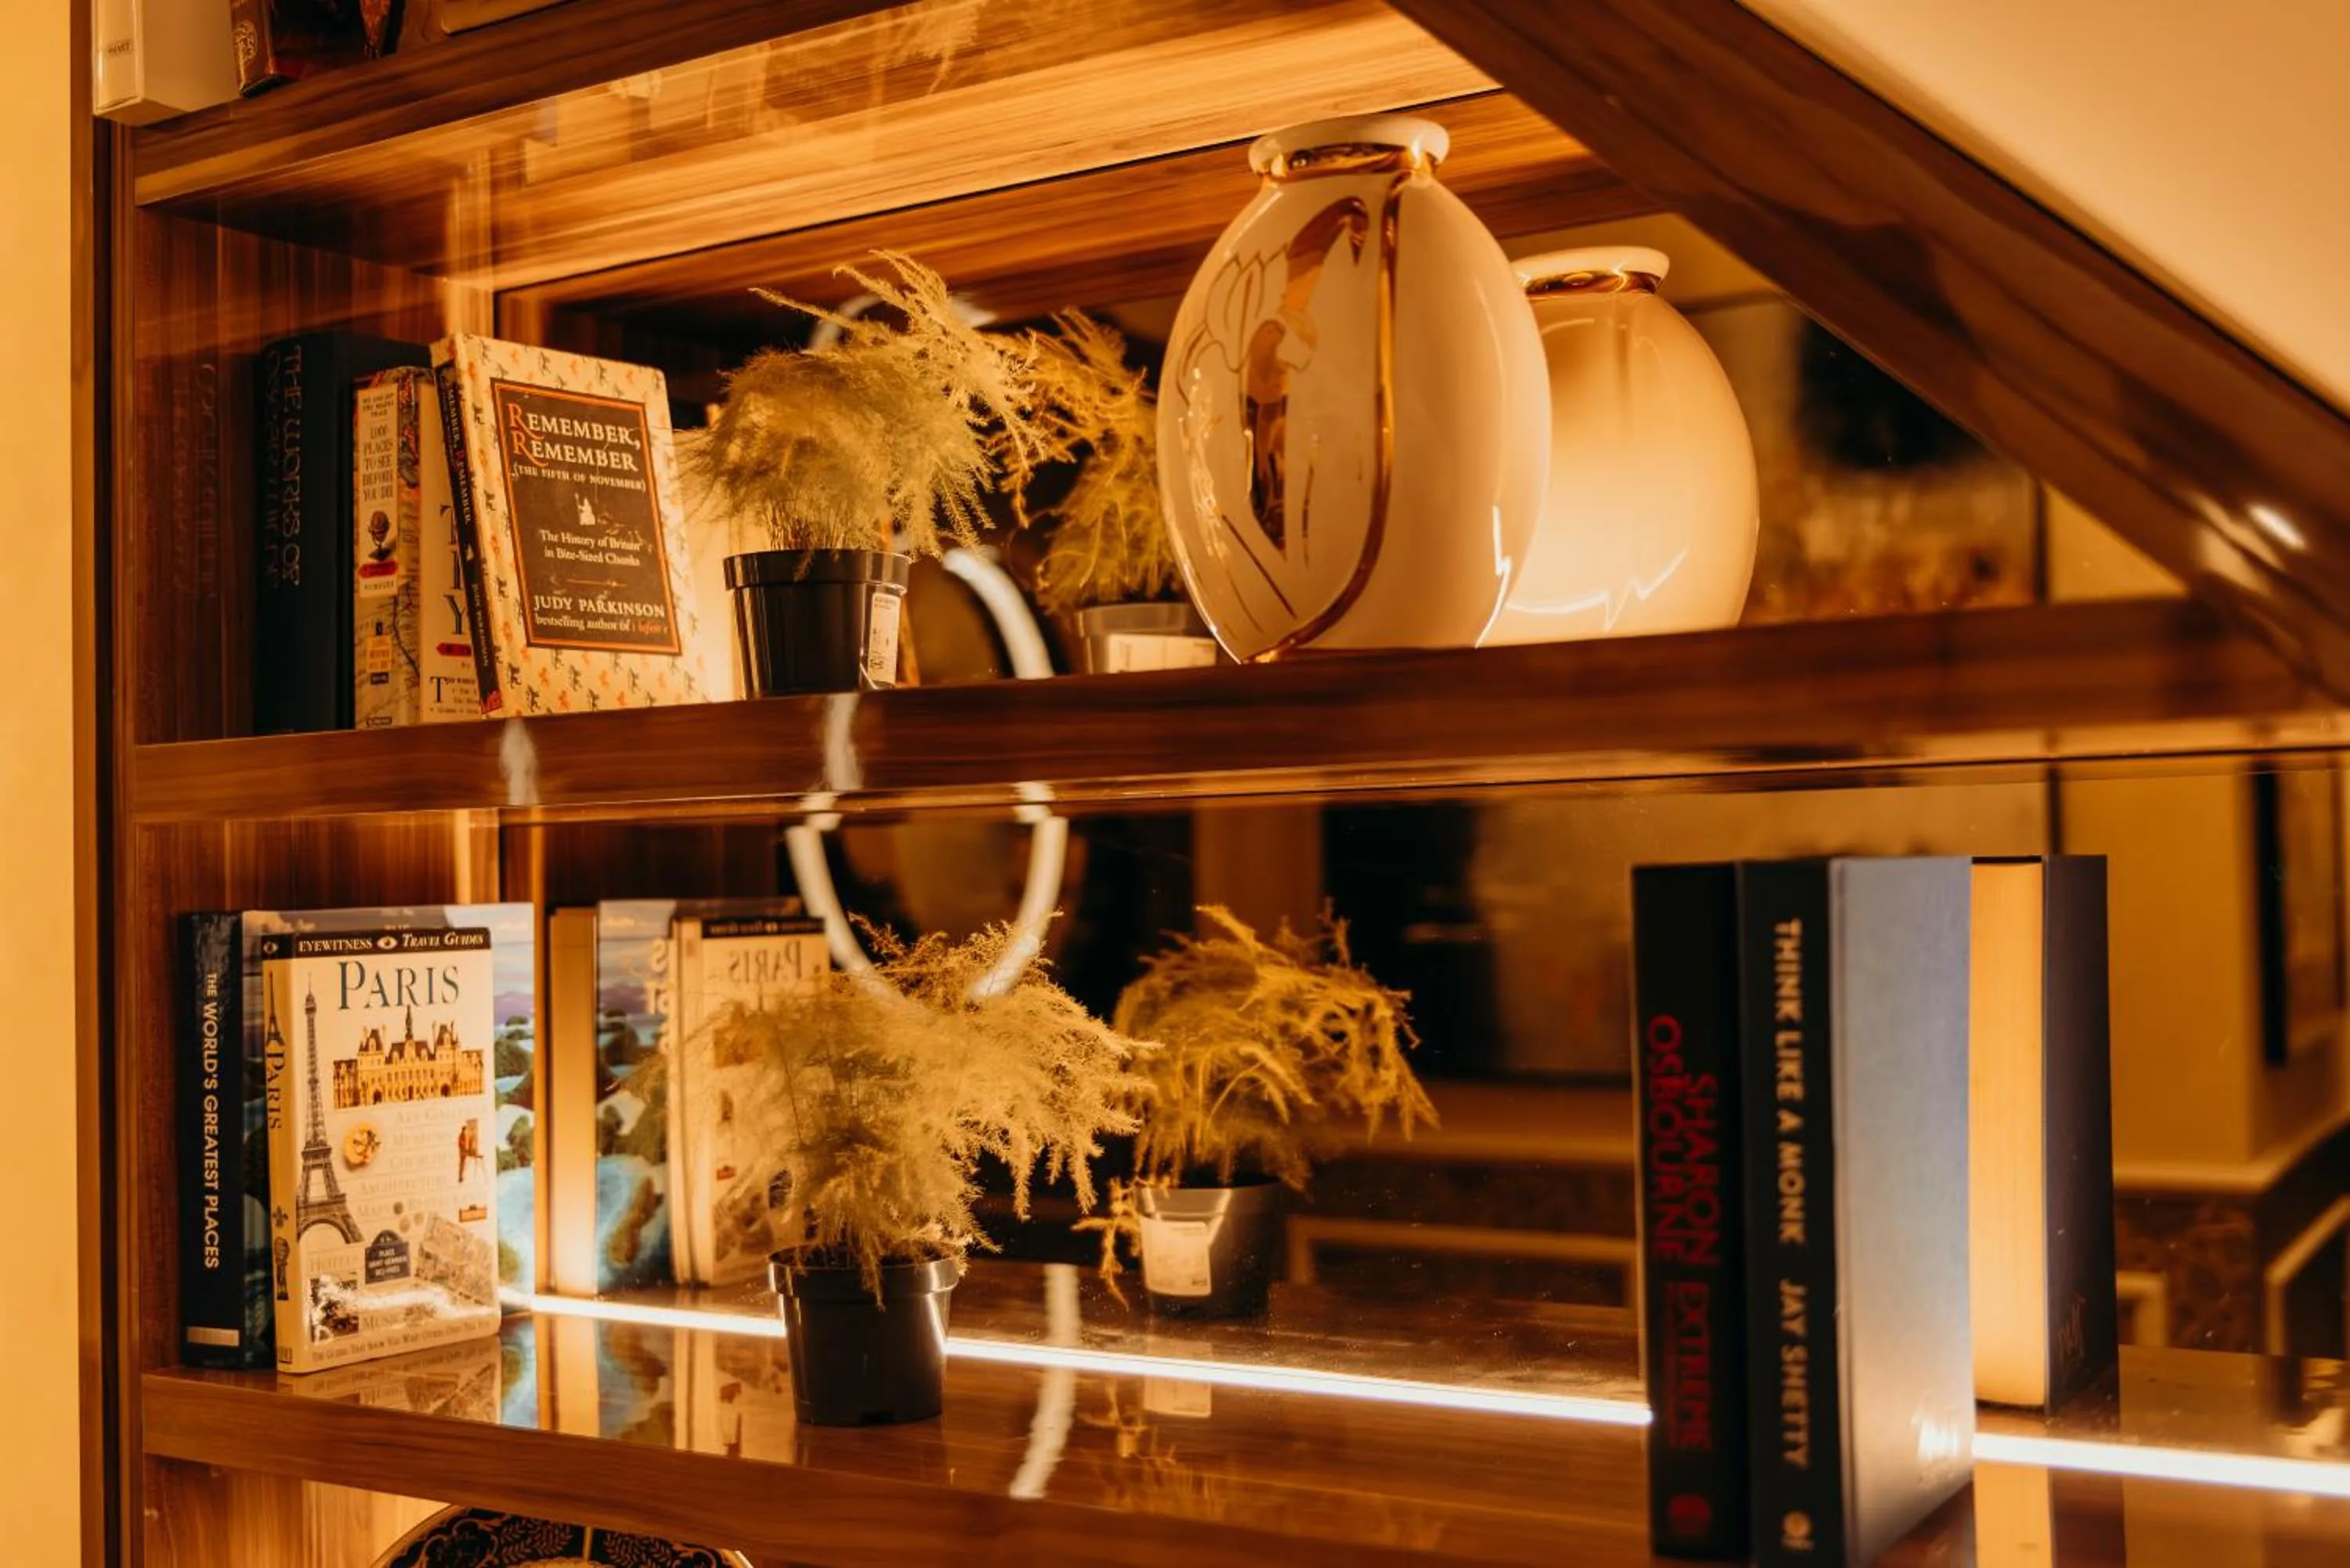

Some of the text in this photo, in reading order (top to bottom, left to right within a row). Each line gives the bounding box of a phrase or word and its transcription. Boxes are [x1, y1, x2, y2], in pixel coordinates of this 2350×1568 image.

[283, 345, 302, 413] THE
[508, 403, 642, 450] REMEMBER,
[511, 430, 638, 471] REMEMBER
[282, 417, 302, 539] WORKS
[573, 472, 586, 482] OF
[539, 529, 559, 542] The
[561, 532, 595, 549] History
[598, 536, 608, 547] of
[544, 547, 555, 558] in
[533, 594, 666, 617] JUDY PARKINSON
[534, 613, 585, 631] bestselling
[586, 617, 618, 630] author
[298, 938, 373, 953] EYEWITNESS
[338, 959, 461, 1011] PARIS
[266, 1050, 286, 1130] PARIS
[1773, 918, 1807, 1244] THINK LIKE A MONK
[203, 972, 220, 1269] THE WORLD'S GREATEST PLACES
[1779, 1278, 1811, 1469] JAY SHETTY
